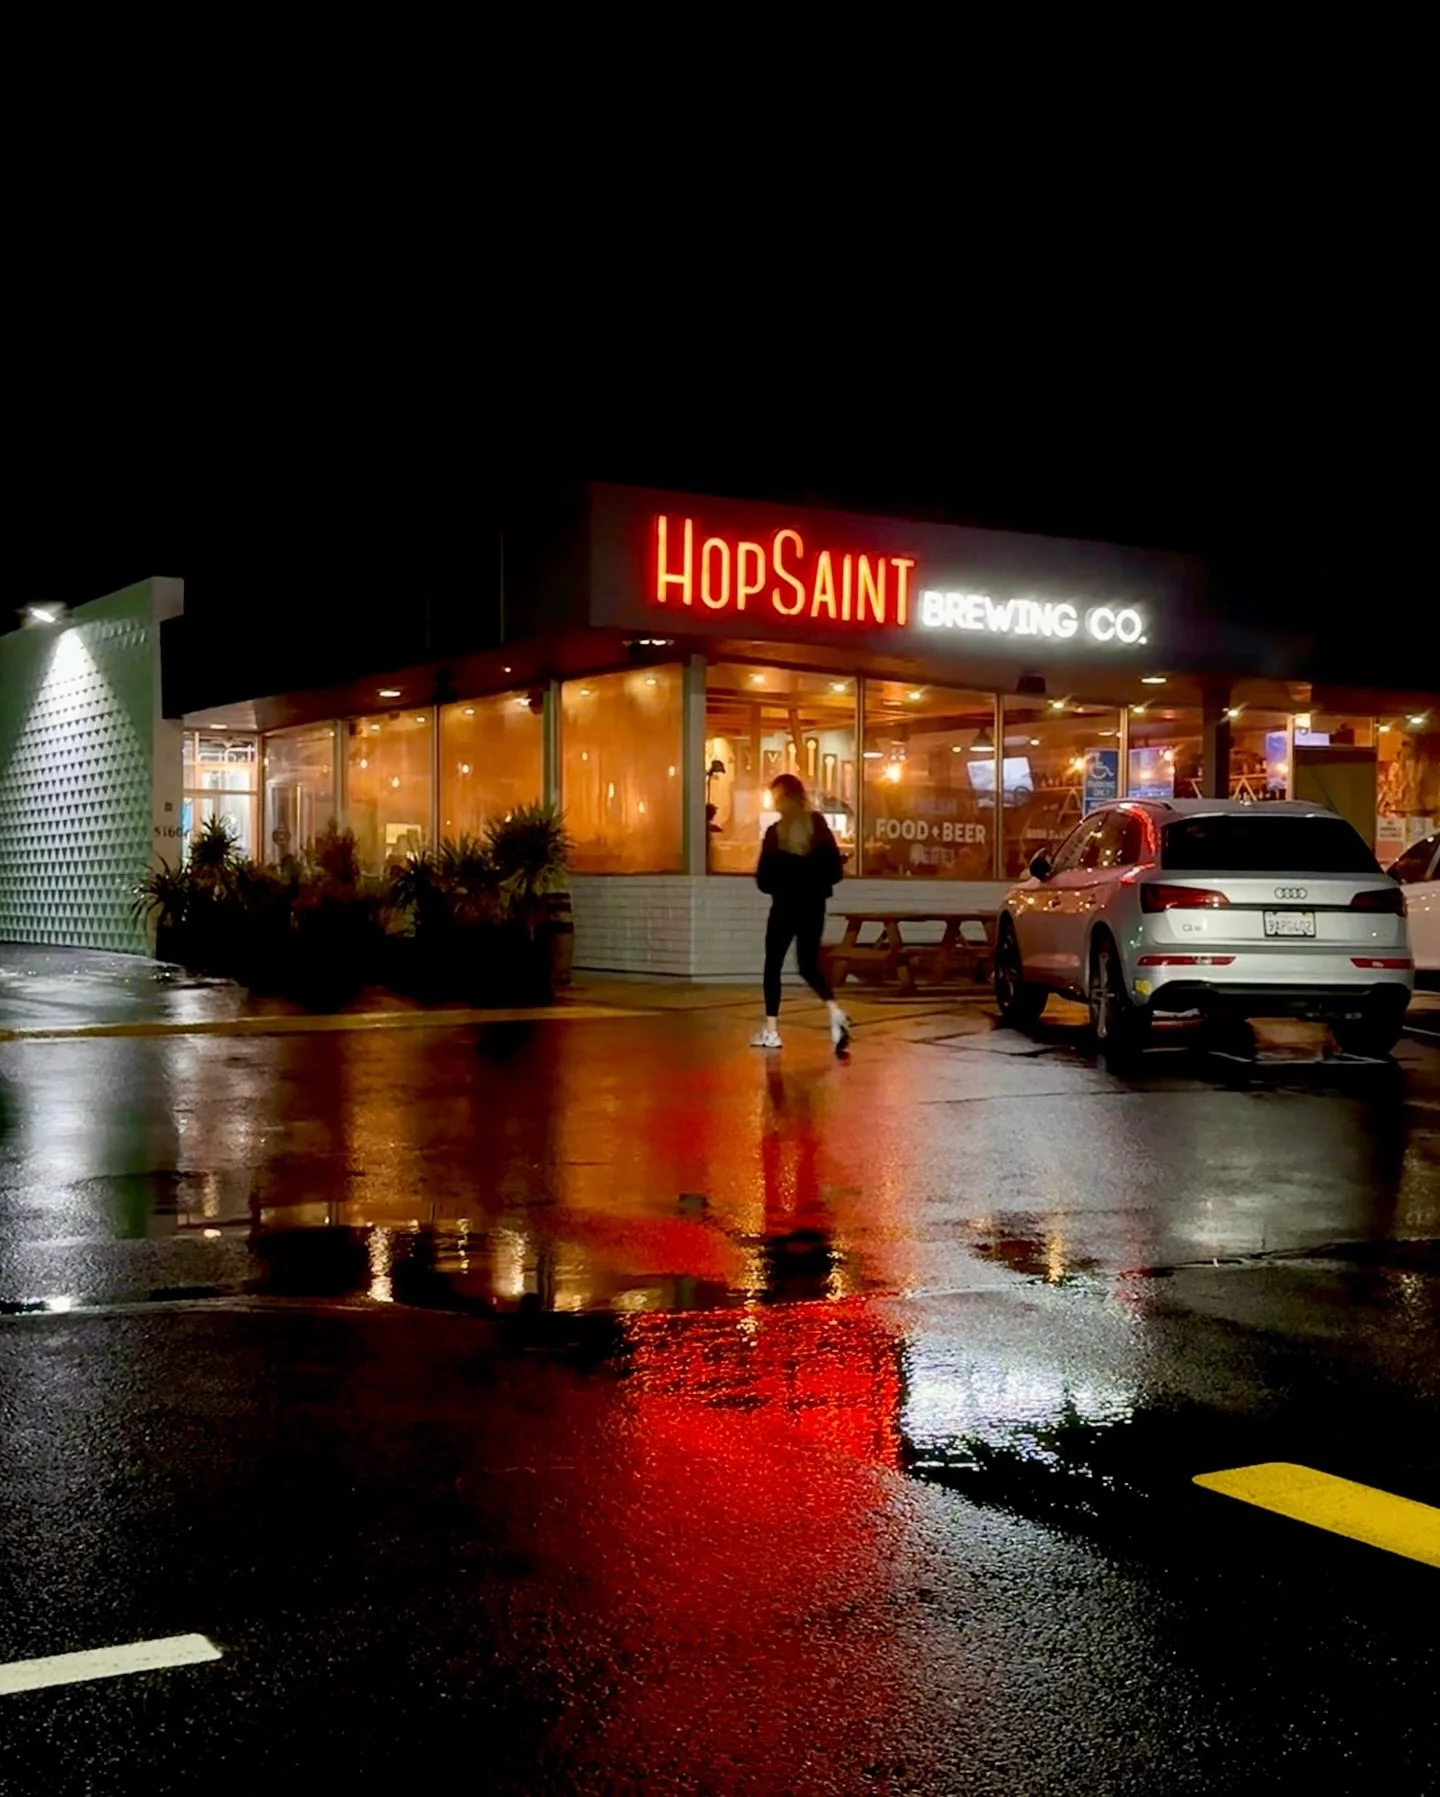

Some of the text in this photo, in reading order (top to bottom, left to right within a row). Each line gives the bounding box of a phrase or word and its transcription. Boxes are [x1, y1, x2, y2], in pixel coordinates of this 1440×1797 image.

[921, 590, 1078, 638] BREWING
[1088, 606, 1148, 644] CO.
[876, 817, 929, 841] FOOD
[943, 822, 987, 845] BEER
